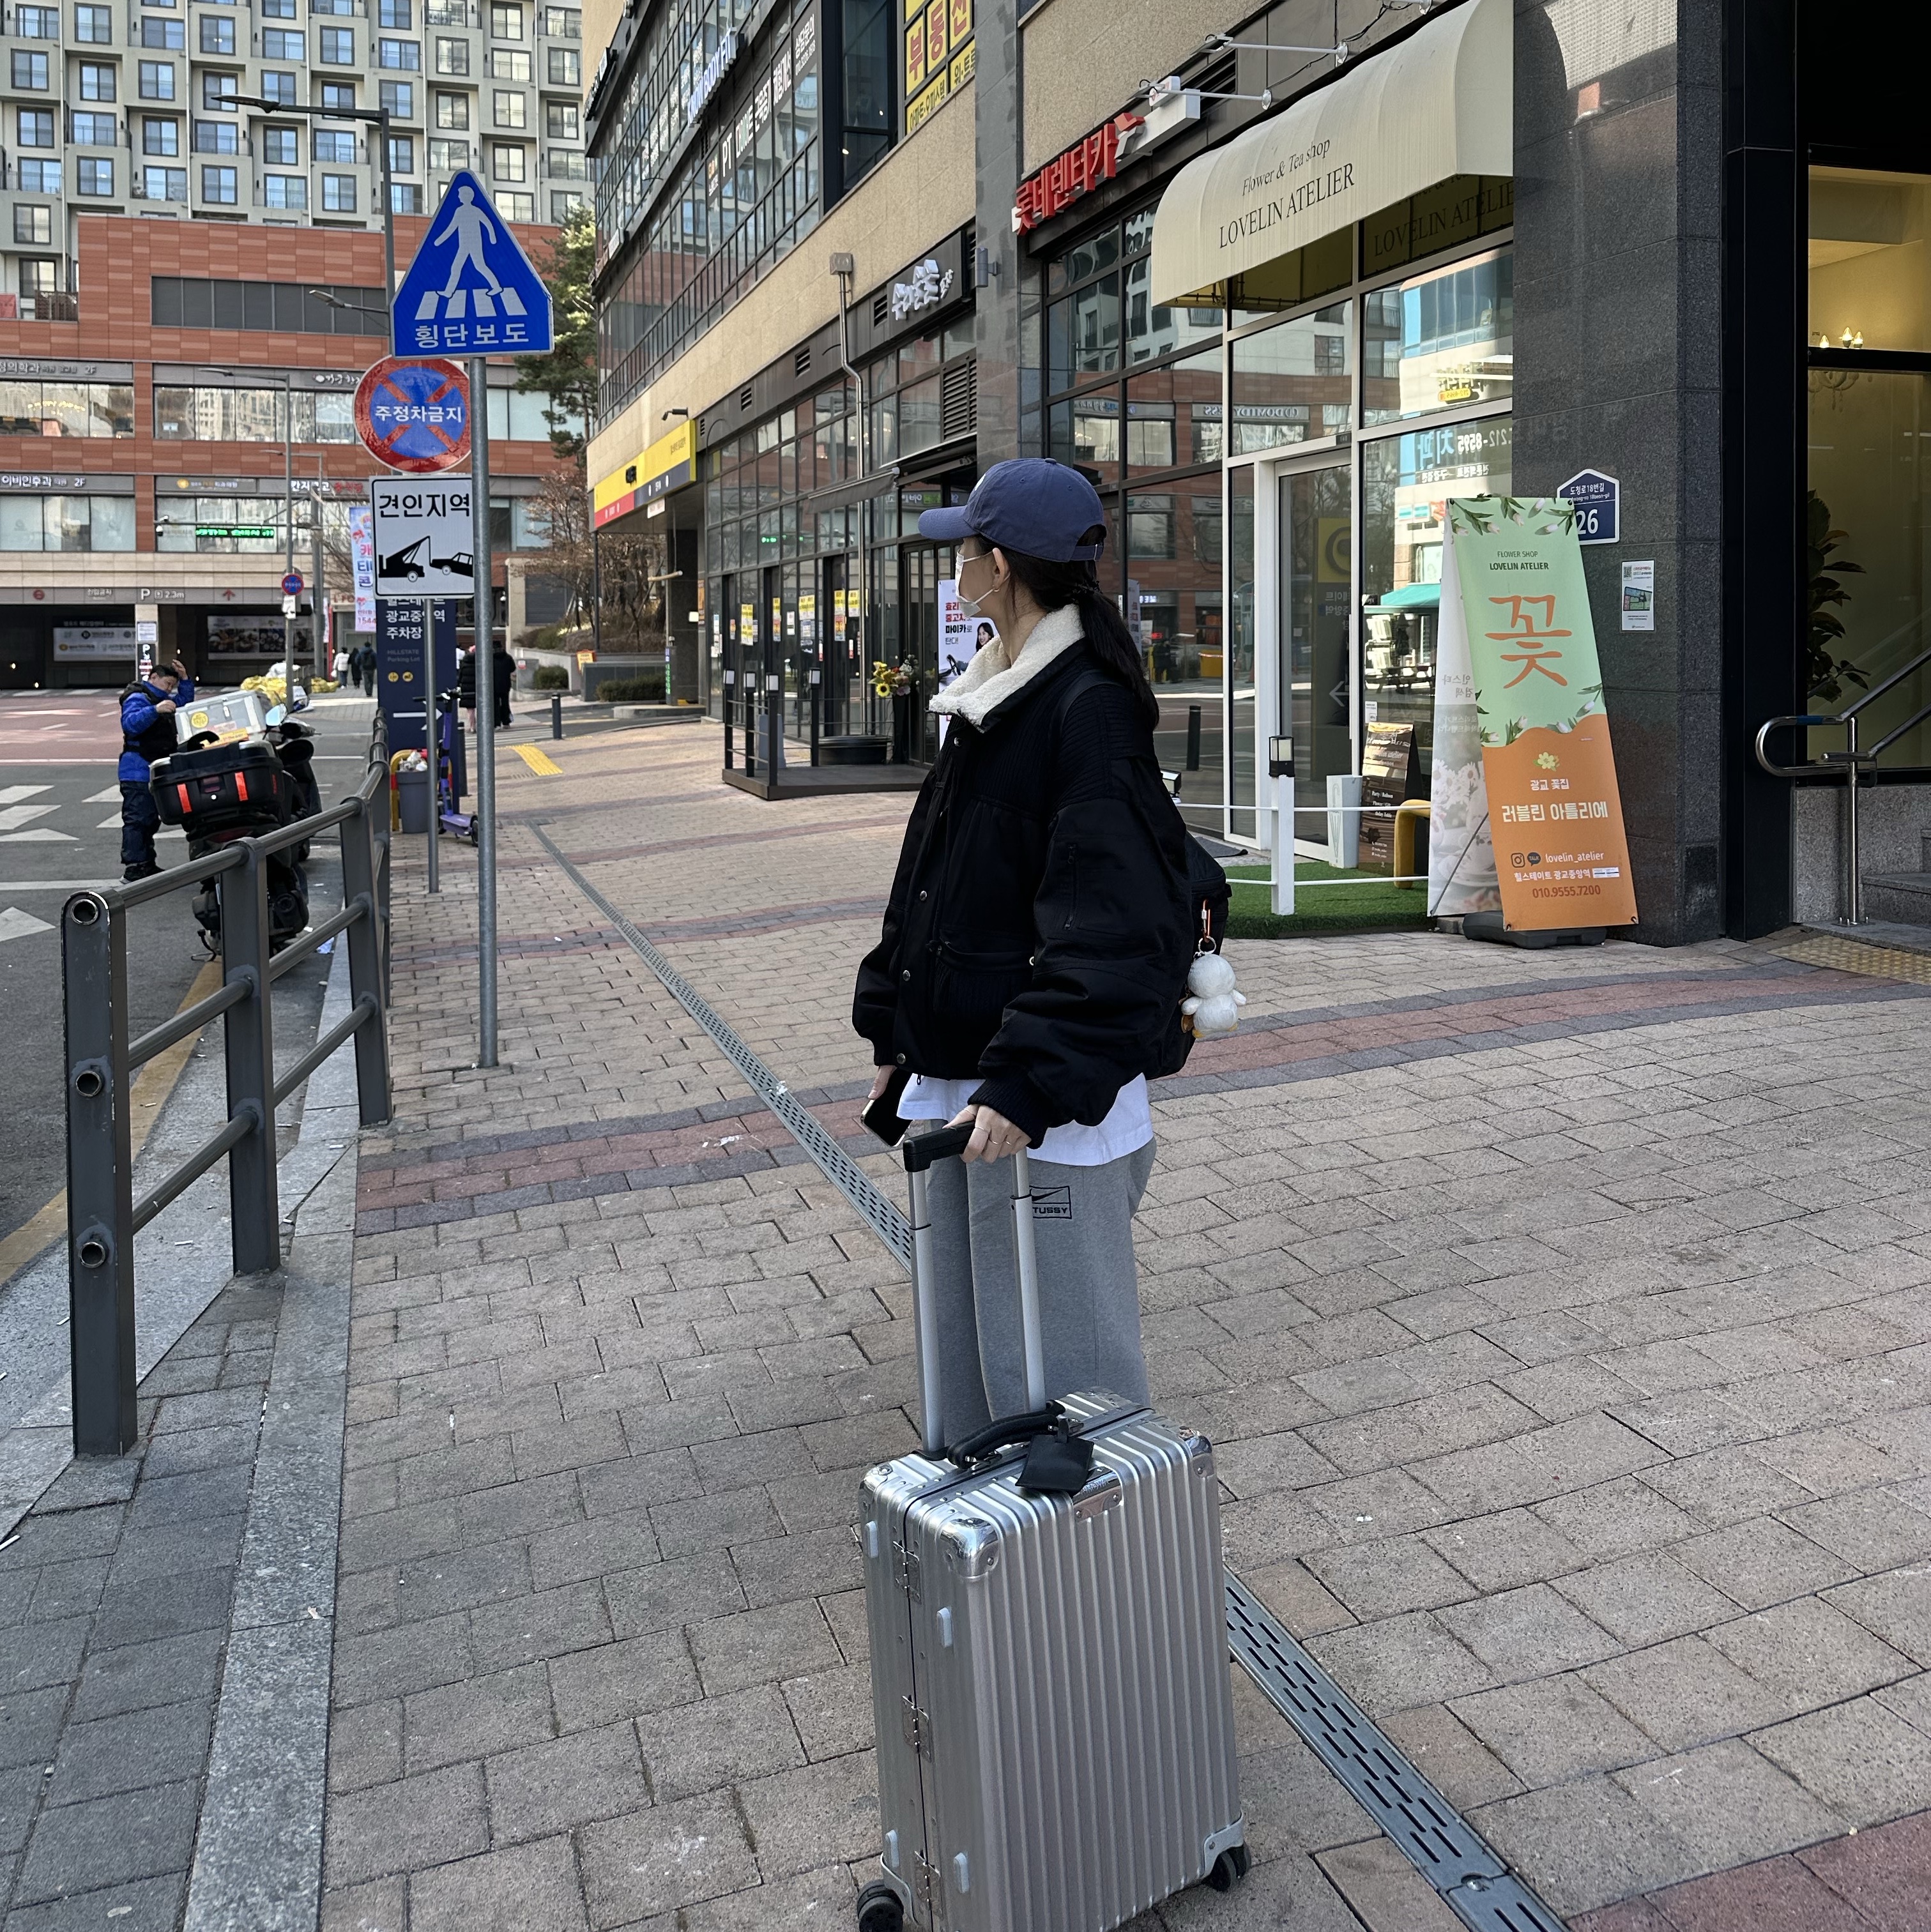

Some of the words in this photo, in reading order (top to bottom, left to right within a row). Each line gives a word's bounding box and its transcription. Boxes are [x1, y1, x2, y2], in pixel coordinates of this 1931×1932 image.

[795, 14, 815, 59] 상담문의
[704, 46, 721, 100] BODY
[722, 132, 733, 177] PT
[1242, 170, 1275, 197] Flower
[1276, 162, 1286, 178] &
[1289, 153, 1304, 172] Tea
[1306, 137, 1331, 164] shop
[1015, 123, 1120, 236] 롯데렌터카
[1219, 199, 1284, 249] LOVELIN
[1286, 162, 1355, 218] ATELIER
[1375, 208, 1447, 257] LOVELIN
[1451, 180, 1514, 228] ATELIE
[415, 323, 529, 349] 횡단보도
[375, 405, 462, 423] 주정차금지
[1, 475, 52, 488] 이비인후과
[73, 476, 86, 488] 2F
[1569, 482, 1605, 496] 도청로18번길
[378, 492, 470, 518] 견인지역
[1575, 508, 1599, 535] 26
[1497, 551, 1521, 559] FLOWER
[1489, 562, 1519, 572] LOVELIN
[1520, 561, 1550, 570] ATELIER
[140, 588, 151, 600] P
[164, 589, 185, 600] 2.3m
[385, 609, 445, 623] 광교중역
[386, 626, 423, 640] 주차장
[945, 624, 973, 634] 마이카로
[945, 637, 959, 645] 탄다!
[1484, 593, 1573, 690] 꽃
[142, 644, 151, 653] P
[1530, 779, 1549, 791] 광교
[1551, 778, 1570, 791] 꽃집
[1501, 803, 1546, 823] 러블린
[1550, 800, 1609, 821] 아틀리에
[1545, 850, 1605, 863] lovelin_atelier
[1513, 871, 1553, 882] 힐스테이트
[1553, 869, 1591, 879] 광교중앙역
[1532, 885, 1601, 899] 010.9555.7200
